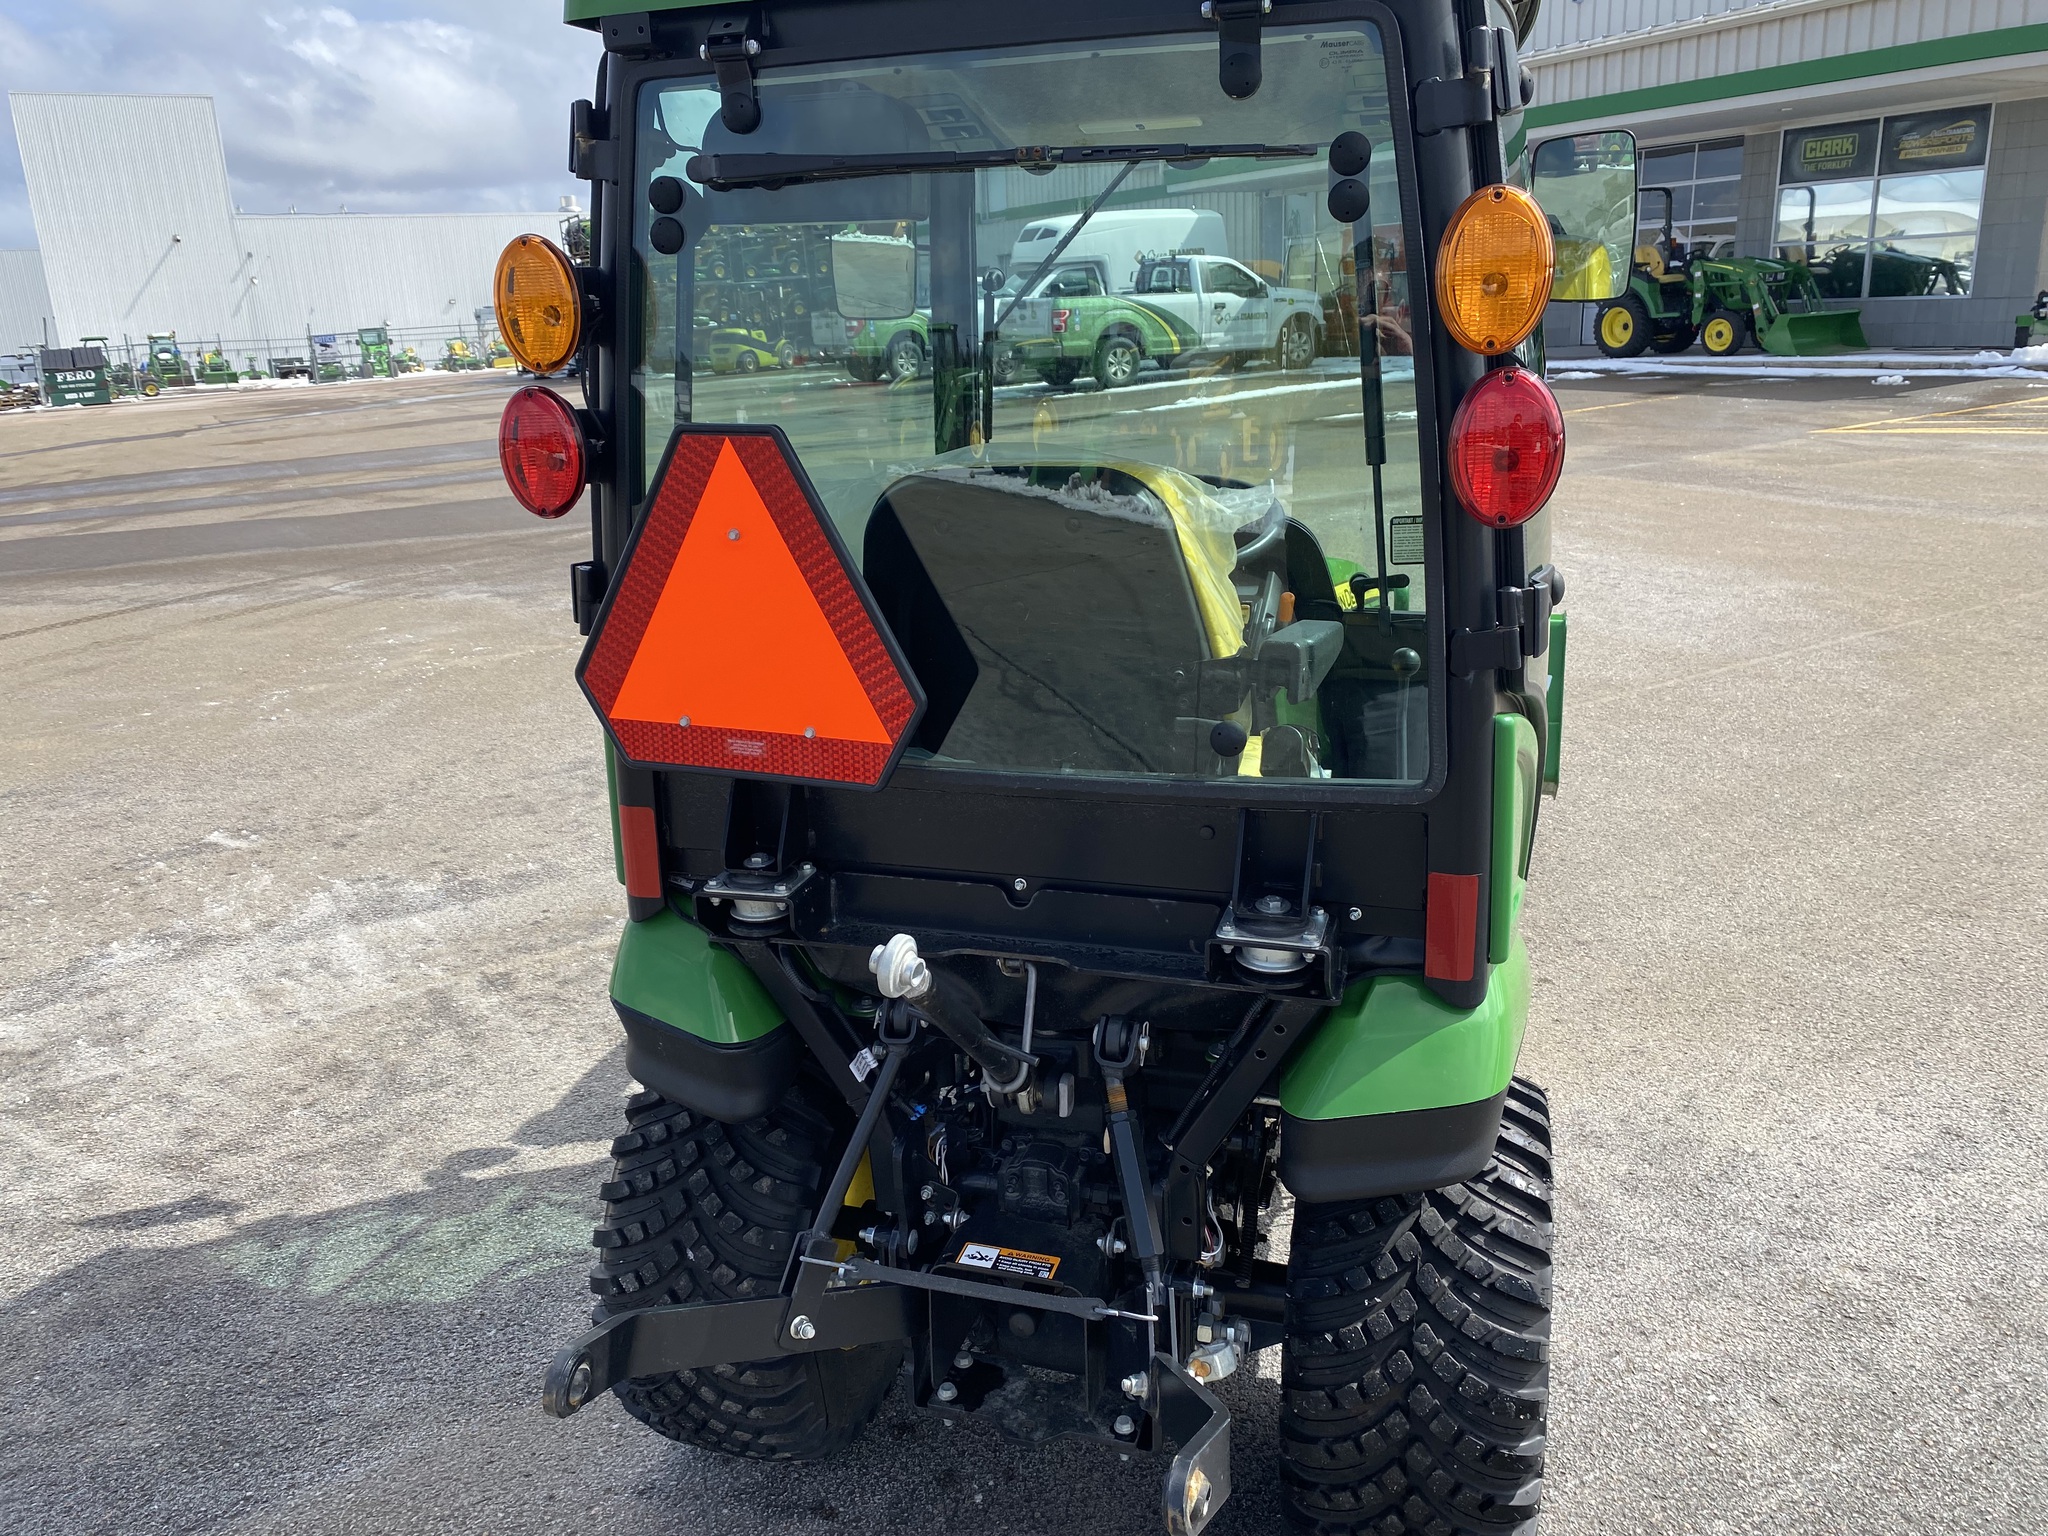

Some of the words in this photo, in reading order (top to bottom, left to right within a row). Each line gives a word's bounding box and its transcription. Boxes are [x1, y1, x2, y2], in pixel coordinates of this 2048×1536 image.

[1805, 137, 1854, 158] CLARK
[1904, 145, 1964, 158] PRE-OWNED
[1804, 162, 1817, 172] THE
[1818, 159, 1853, 171] FORKLIFT
[54, 369, 96, 383] FERO
[1015, 1252, 1051, 1262] WARNING
